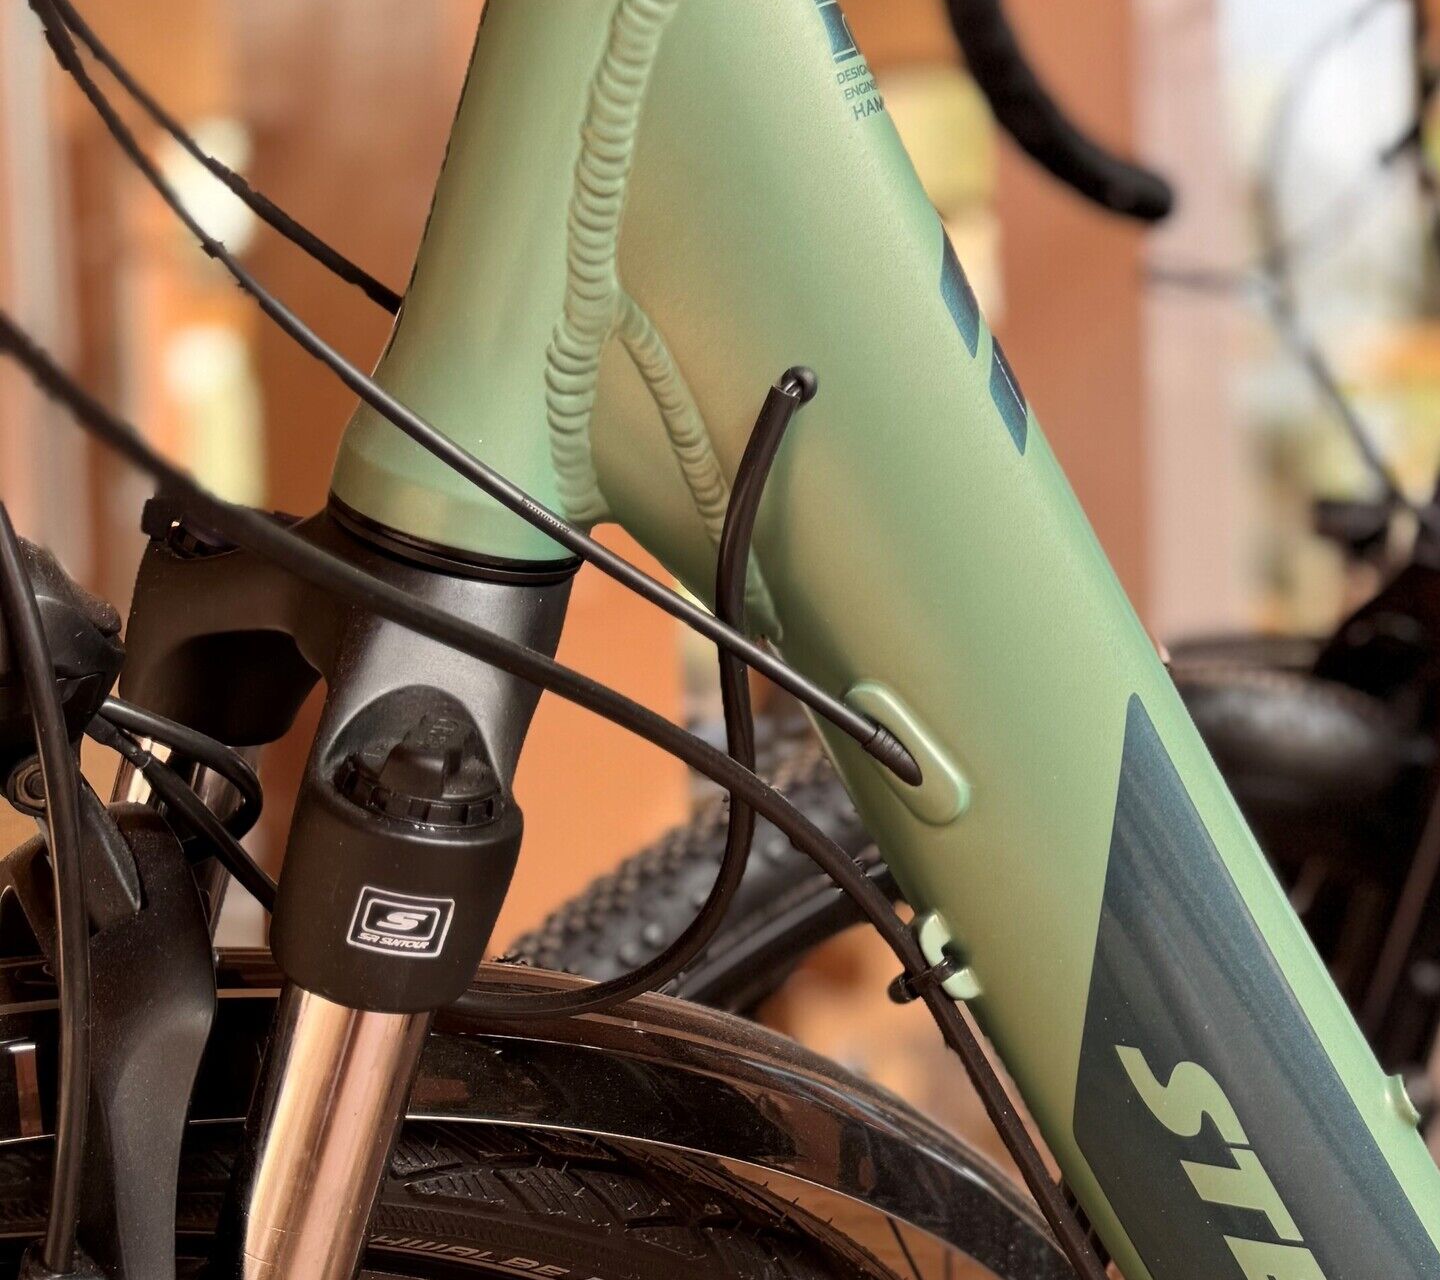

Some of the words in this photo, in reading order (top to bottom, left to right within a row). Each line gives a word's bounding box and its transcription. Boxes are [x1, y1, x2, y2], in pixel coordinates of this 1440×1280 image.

[852, 96, 885, 121] HAM
[379, 937, 430, 950] SUNTOUR
[369, 1234, 571, 1277] HWALBE
